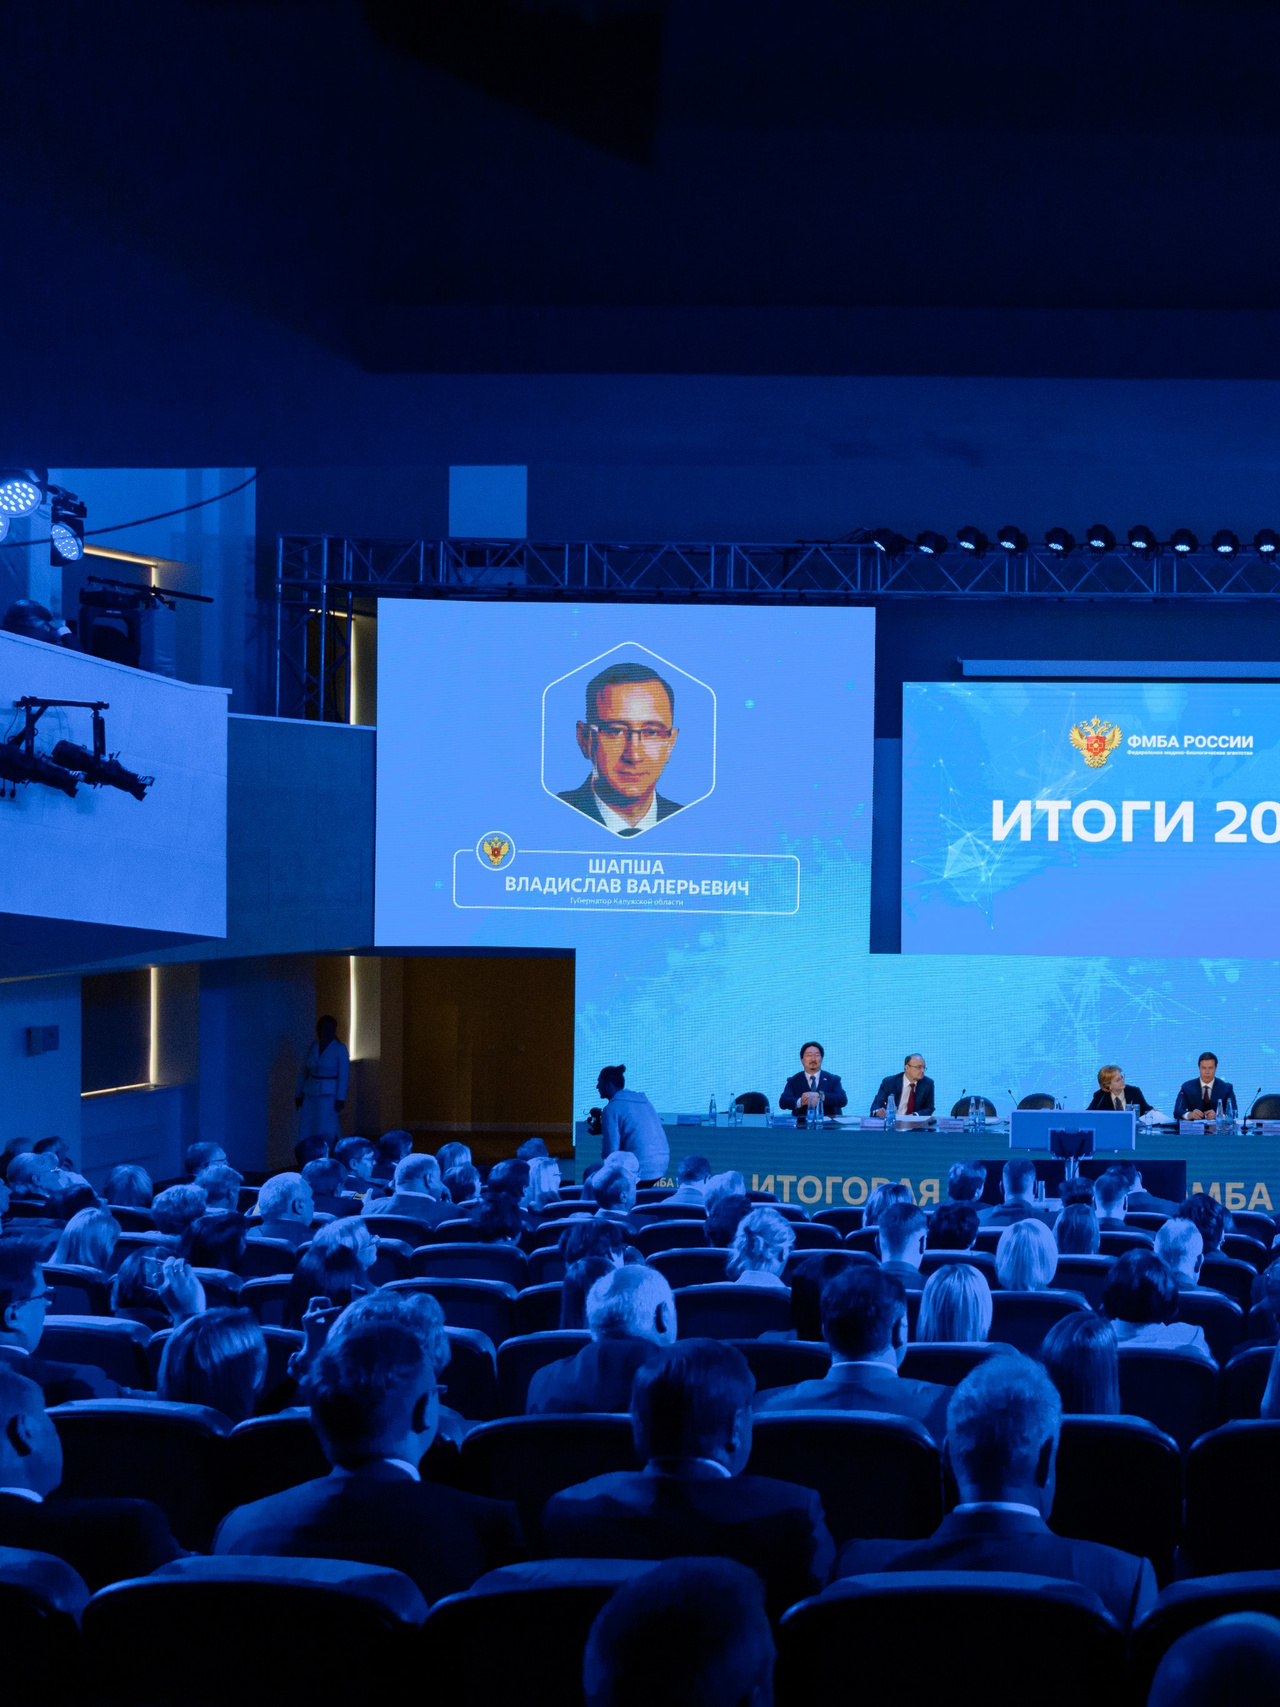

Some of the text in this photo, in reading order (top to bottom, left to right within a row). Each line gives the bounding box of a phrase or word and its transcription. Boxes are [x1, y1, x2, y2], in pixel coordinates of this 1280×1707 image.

[1127, 735, 1254, 748] ФМБА РОССИИ
[992, 800, 1194, 842] ИТОГИ
[588, 859, 664, 875] ШАПША
[505, 876, 749, 896] ВЛАДИСЛАВ ВАЛЕРЬЕВИЧ
[570, 897, 612, 905] Губернатор
[1186, 1182, 1273, 1210] МБА
